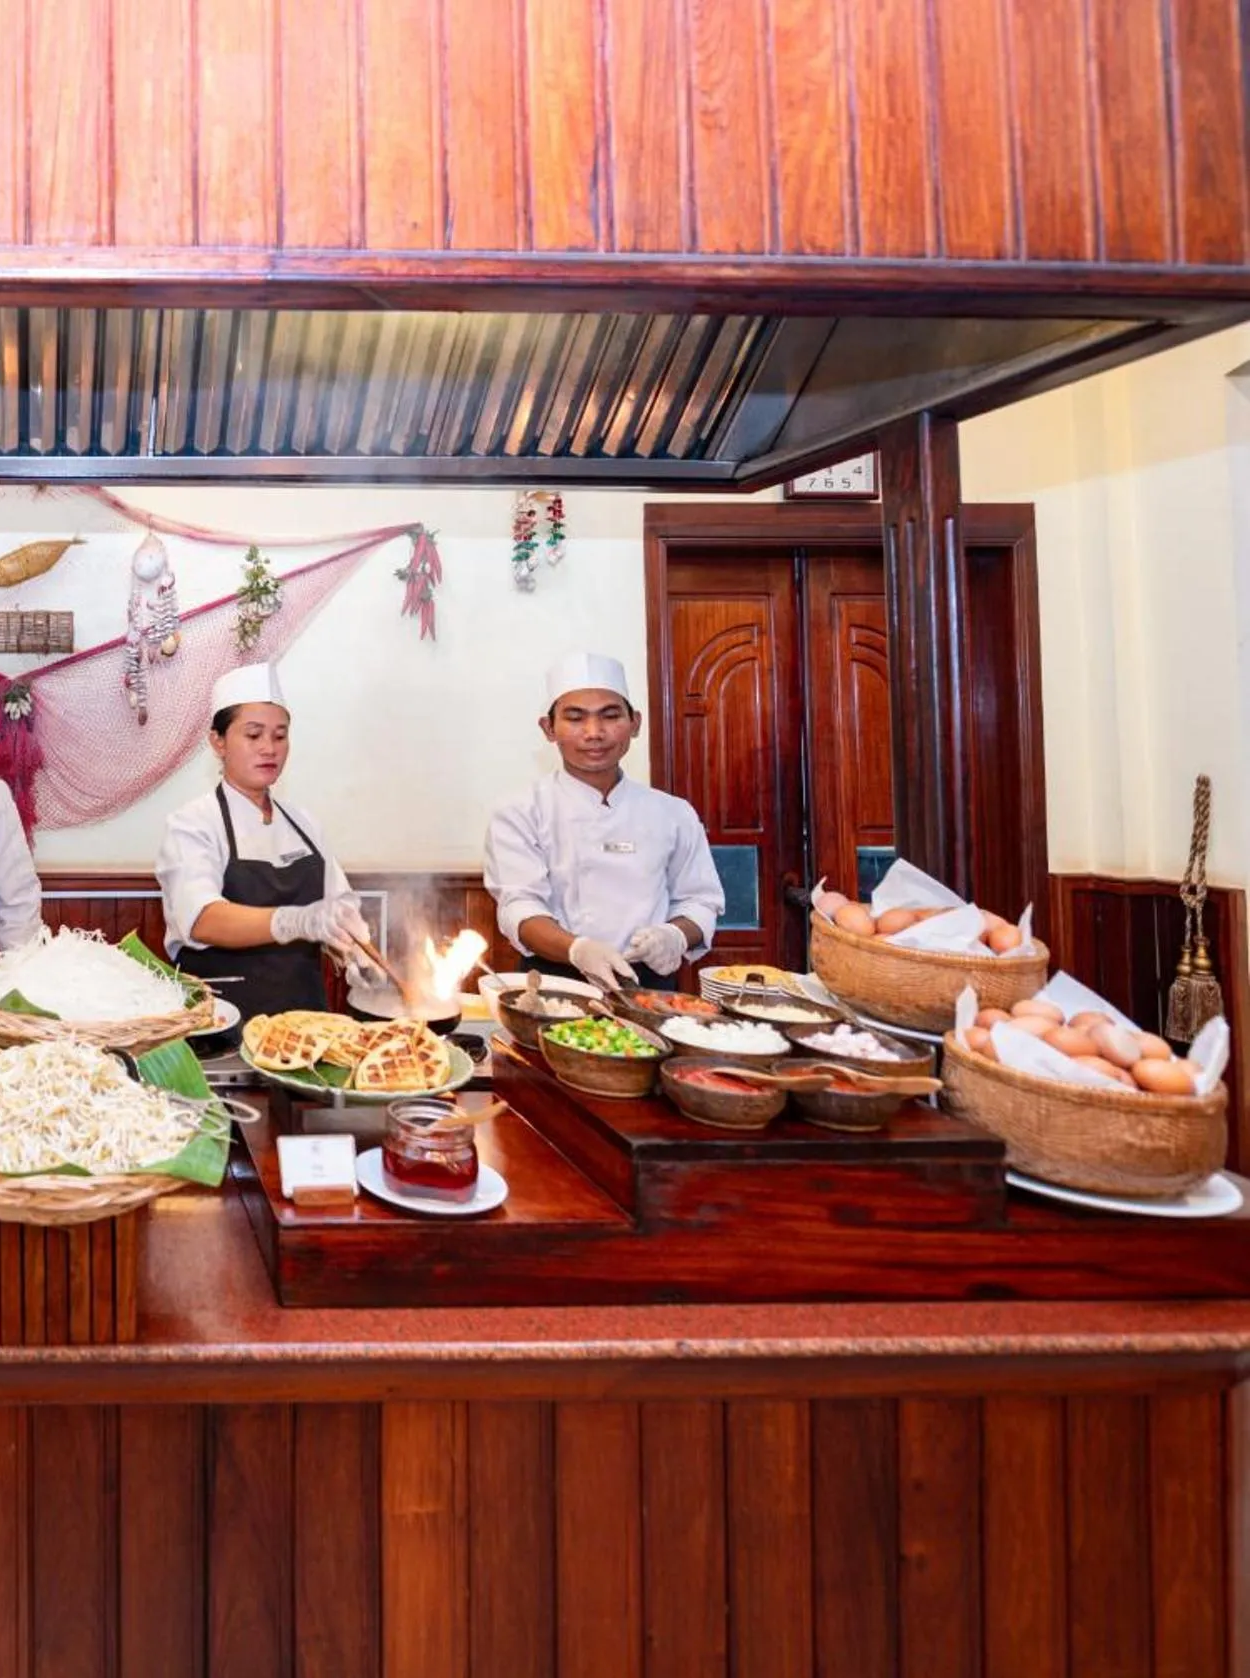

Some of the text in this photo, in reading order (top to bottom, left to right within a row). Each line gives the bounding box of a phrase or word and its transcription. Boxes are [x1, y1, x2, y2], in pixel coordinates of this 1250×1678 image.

[852, 465, 862, 474] 4
[808, 477, 851, 489] 7 6 5
